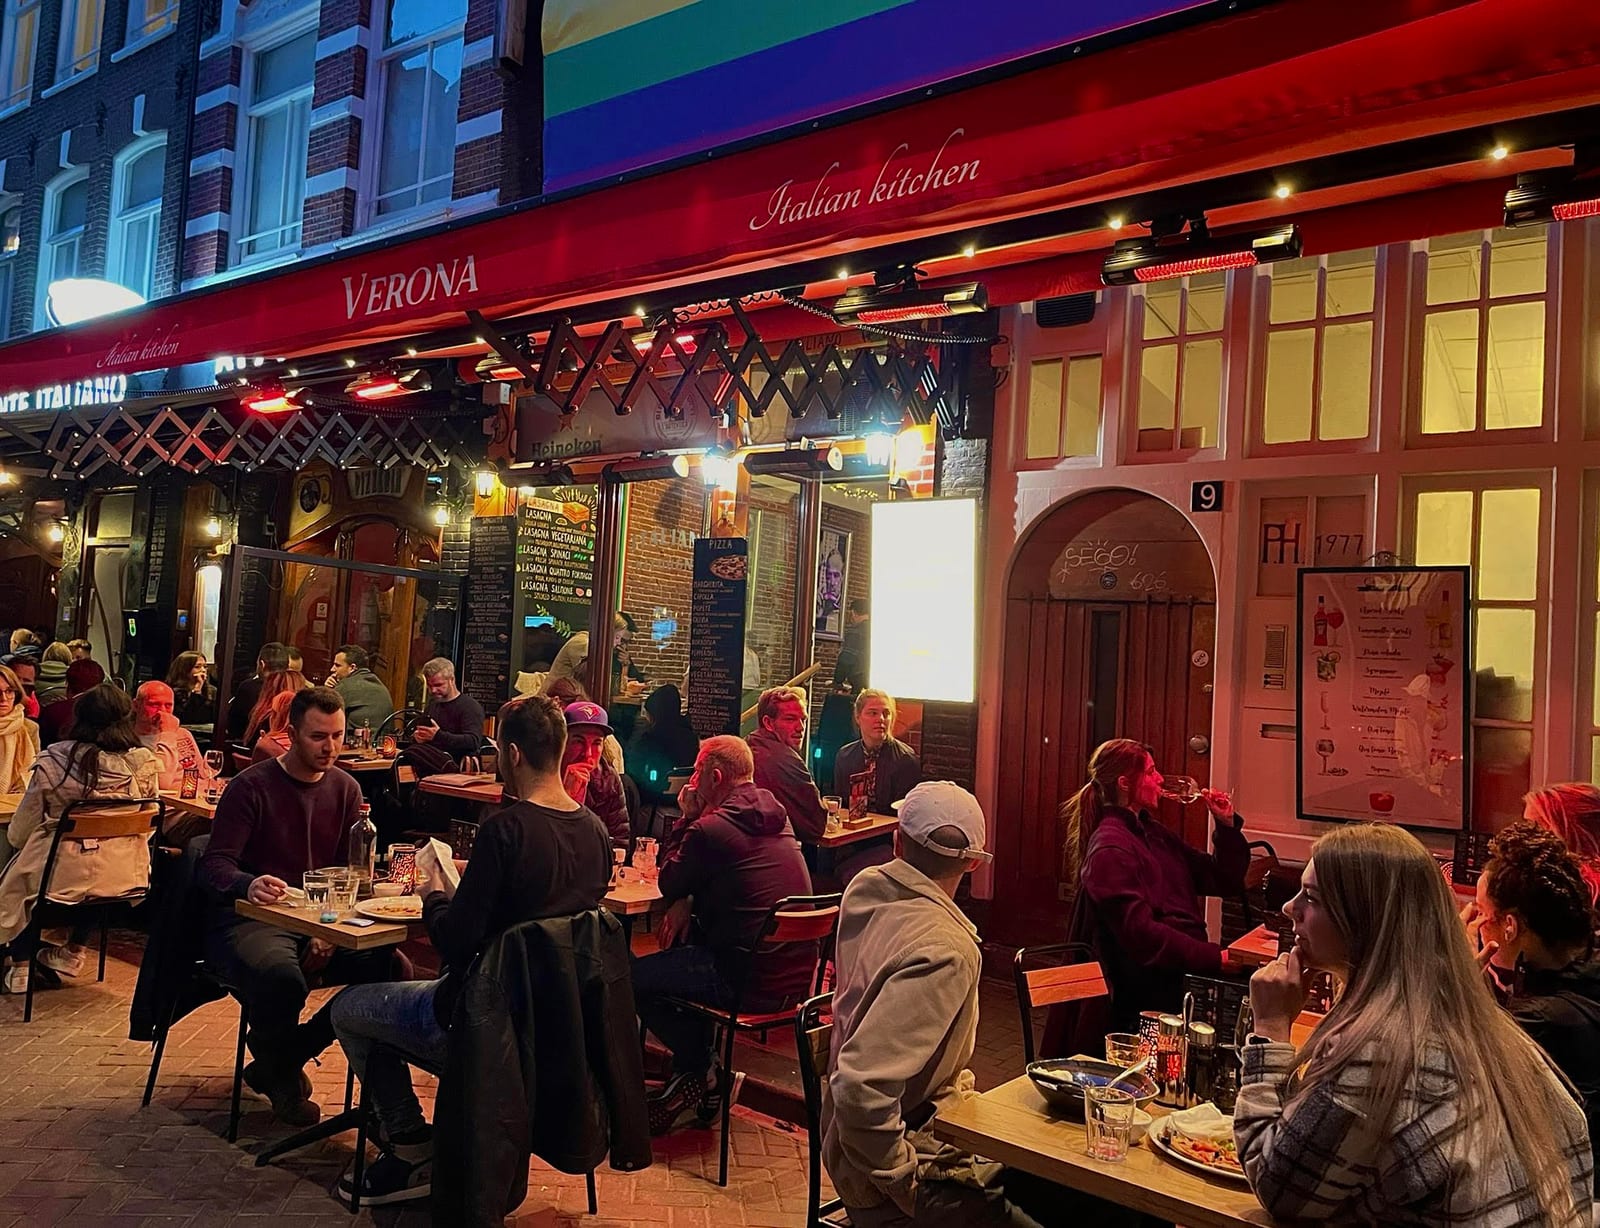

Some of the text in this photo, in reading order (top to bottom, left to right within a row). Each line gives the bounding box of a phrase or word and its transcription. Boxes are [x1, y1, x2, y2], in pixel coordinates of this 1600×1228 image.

[749, 128, 982, 230] Italian kitchen
[342, 255, 479, 320] VERONA
[97, 323, 180, 368] Italian kitchen
[36, 374, 127, 409] ITALIANO
[531, 438, 602, 458] Heineken
[1200, 484, 1216, 510] 9
[525, 509, 552, 522] LASAGNA
[524, 528, 549, 541] LASAGNA
[709, 540, 733, 549] PIZZA
[523, 545, 548, 557] LASAGNA
[1315, 534, 1364, 556] 1977
[521, 563, 548, 575] LASAGNA
[520, 581, 549, 592] LASAGNA
